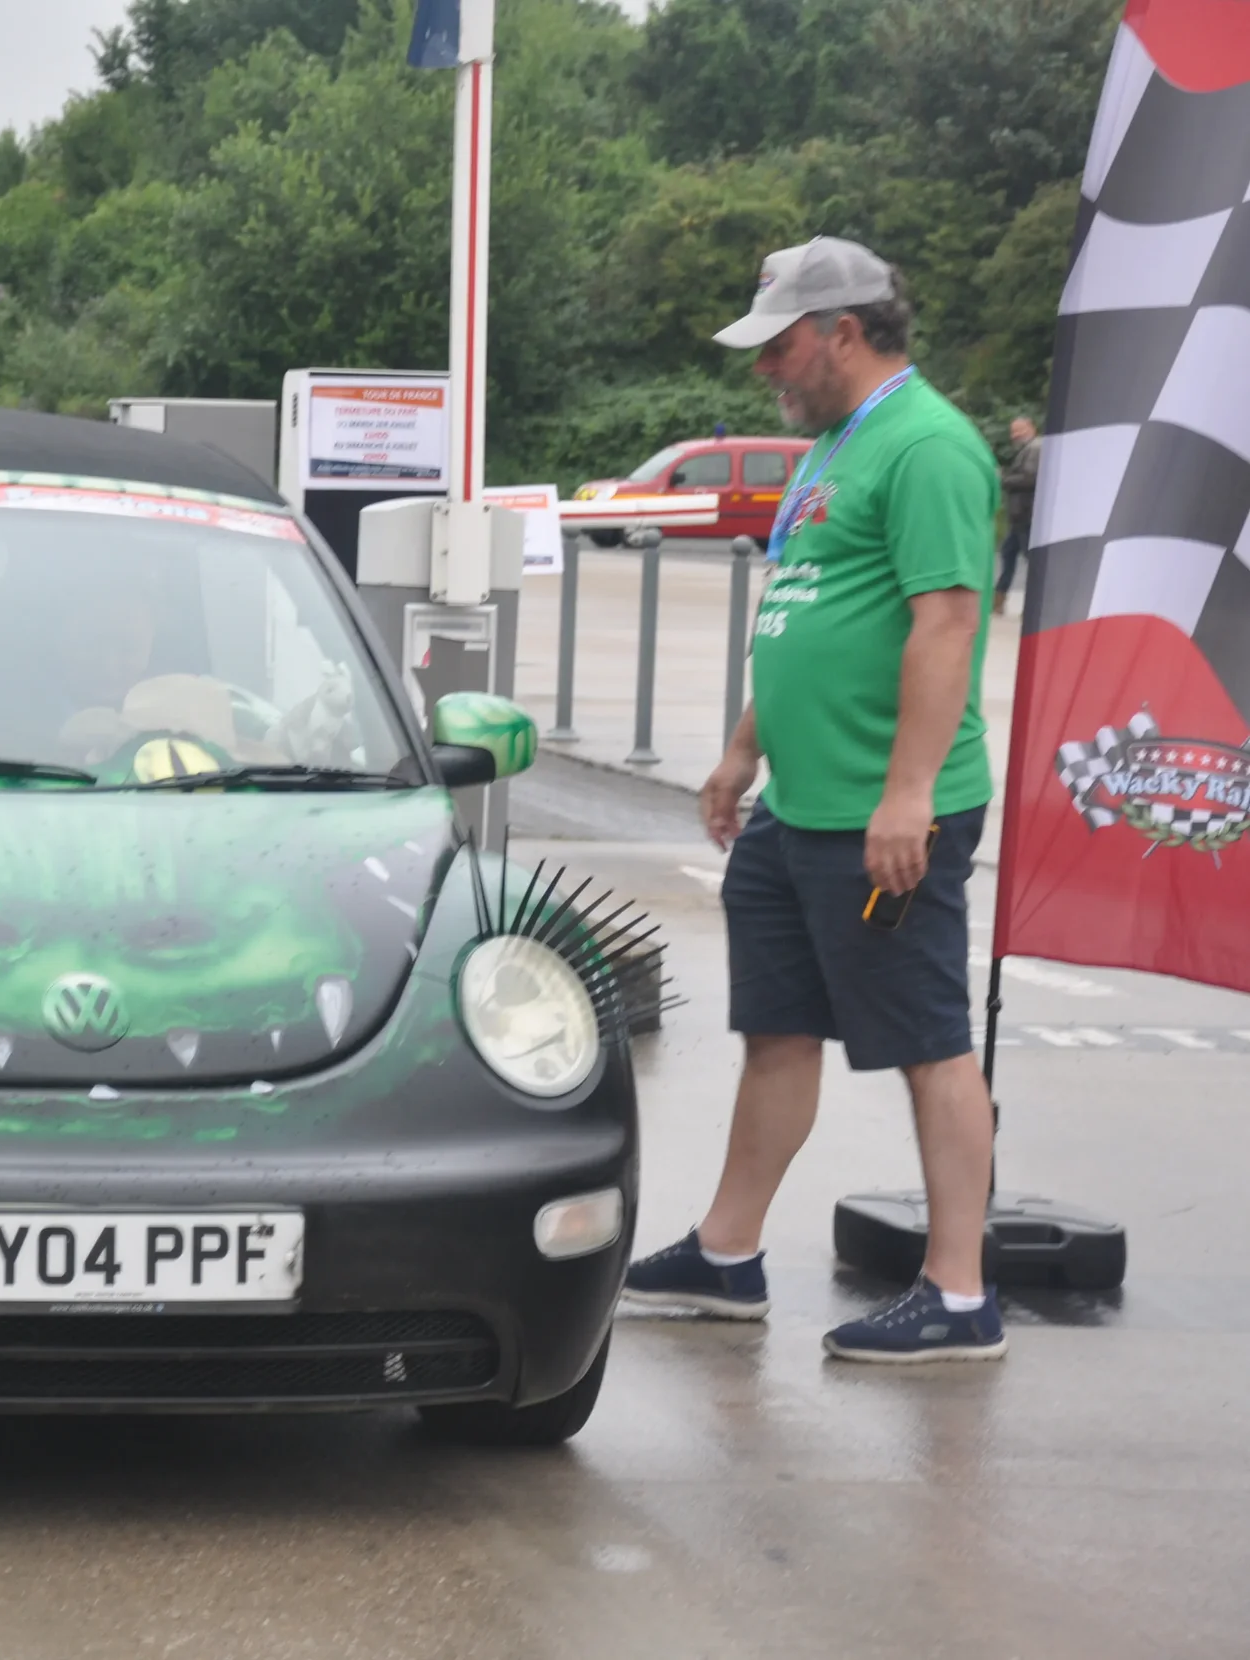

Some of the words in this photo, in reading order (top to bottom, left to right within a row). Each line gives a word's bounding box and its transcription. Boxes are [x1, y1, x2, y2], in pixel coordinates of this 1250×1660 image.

[1102, 771, 1200, 801] Wacky
[1205, 774, 1250, 812] Ral
[145, 1224, 276, 1285] PPF
